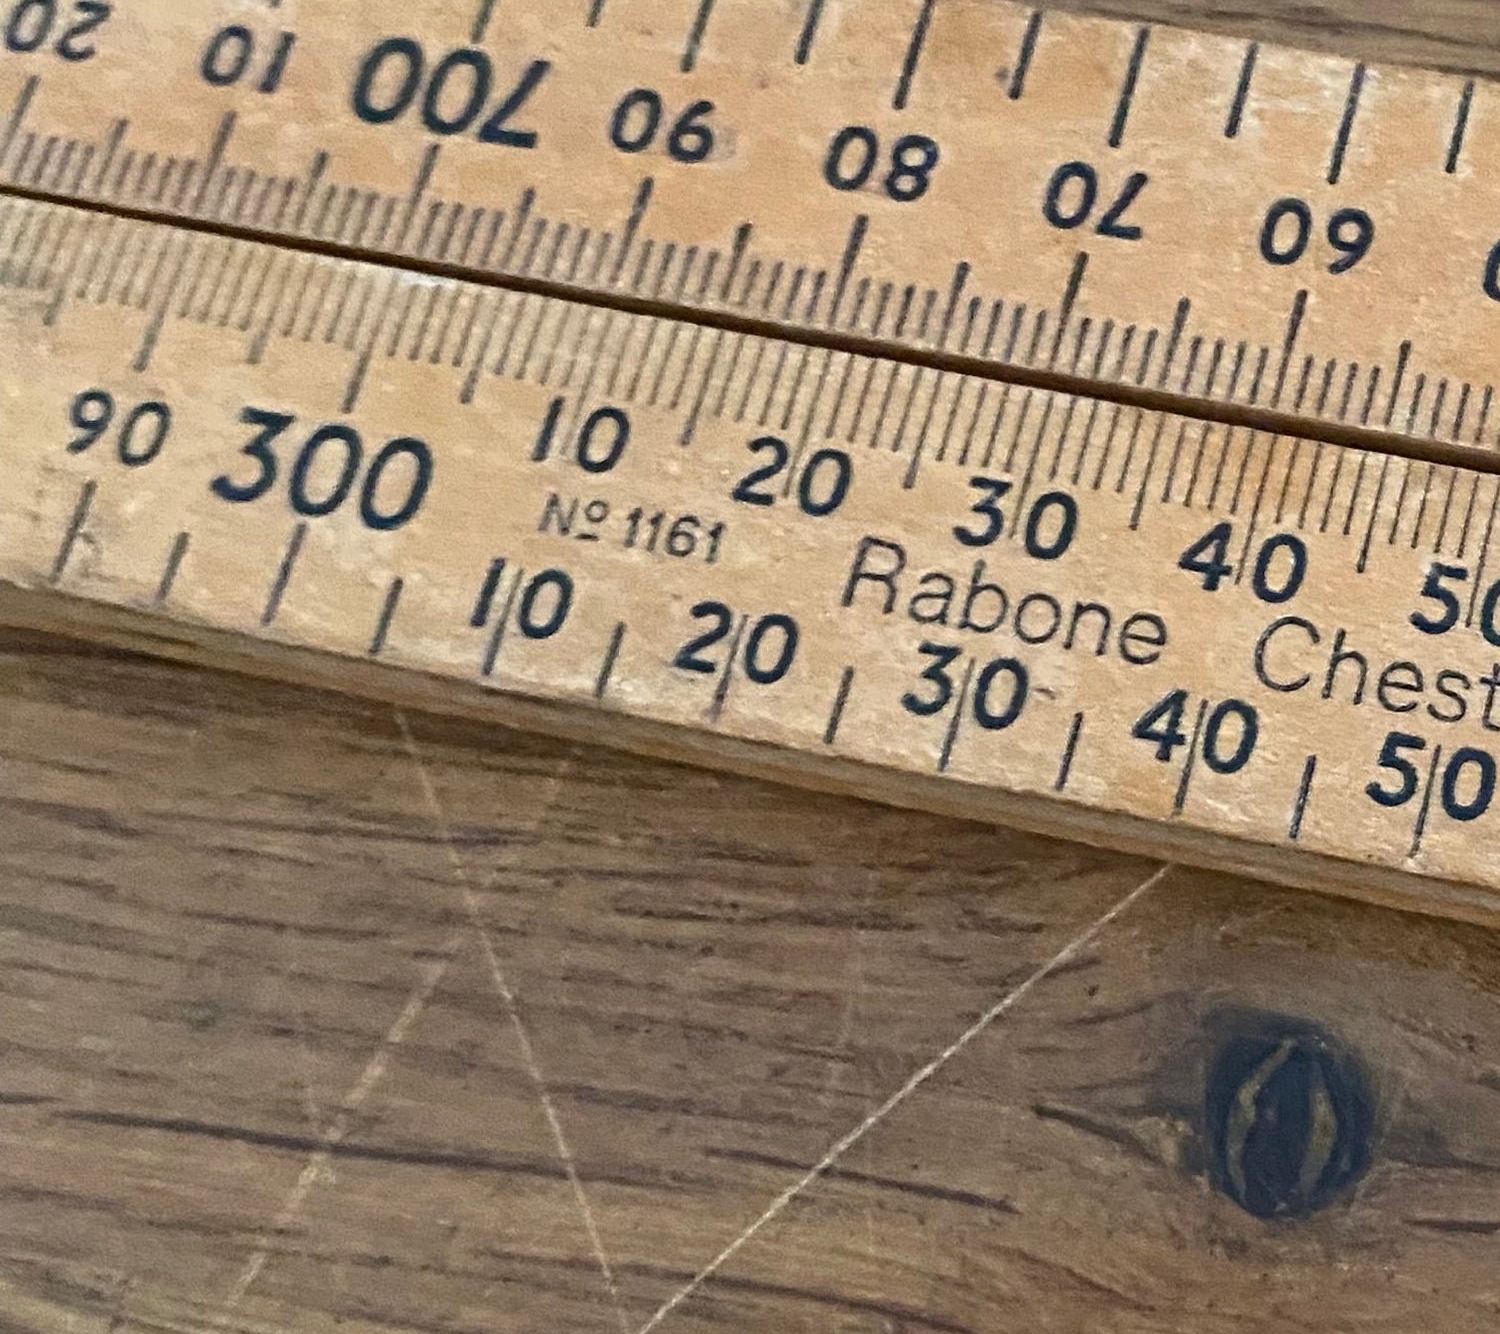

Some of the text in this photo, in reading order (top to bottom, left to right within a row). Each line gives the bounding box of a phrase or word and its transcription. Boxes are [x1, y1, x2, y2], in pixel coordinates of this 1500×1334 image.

[202, 25, 296, 94] 10
[352, 36, 552, 150] 700
[610, 90, 716, 163] 90
[823, 126, 939, 201] 80
[1044, 161, 1149, 240] 70
[1259, 198, 1375, 273] 60
[69, 389, 172, 467] 90
[211, 406, 434, 532] 300
[530, 397, 631, 475] 10
[732, 437, 853, 518] 20
[953, 477, 1079, 561] 30
[1178, 522, 1308, 605] 40
[624, 507, 726, 563] 1161
[841, 536, 1169, 665] Rabone
[470, 557, 574, 640] 10
[674, 602, 800, 684] 20
[900, 643, 1029, 730] 30
[1131, 689, 1260, 775] 40
[1364, 732, 1498, 822] 50
